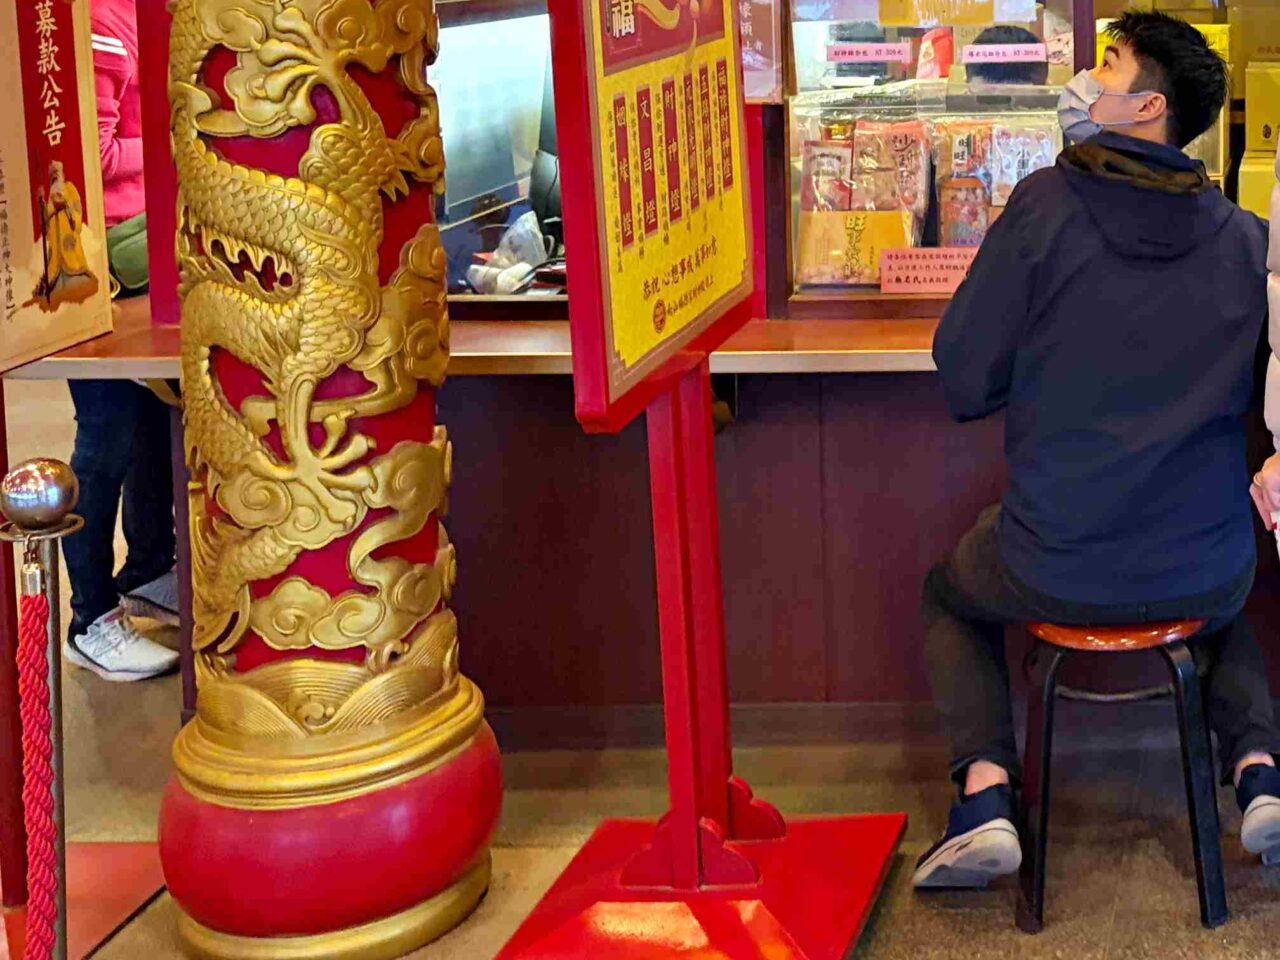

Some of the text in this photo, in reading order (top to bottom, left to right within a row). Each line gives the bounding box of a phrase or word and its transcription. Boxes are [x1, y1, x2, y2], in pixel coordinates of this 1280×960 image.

[34, 0, 66, 148] 募款公告
[639, 97, 657, 225] 文昌燈
[663, 88, 681, 213] 財神燈
